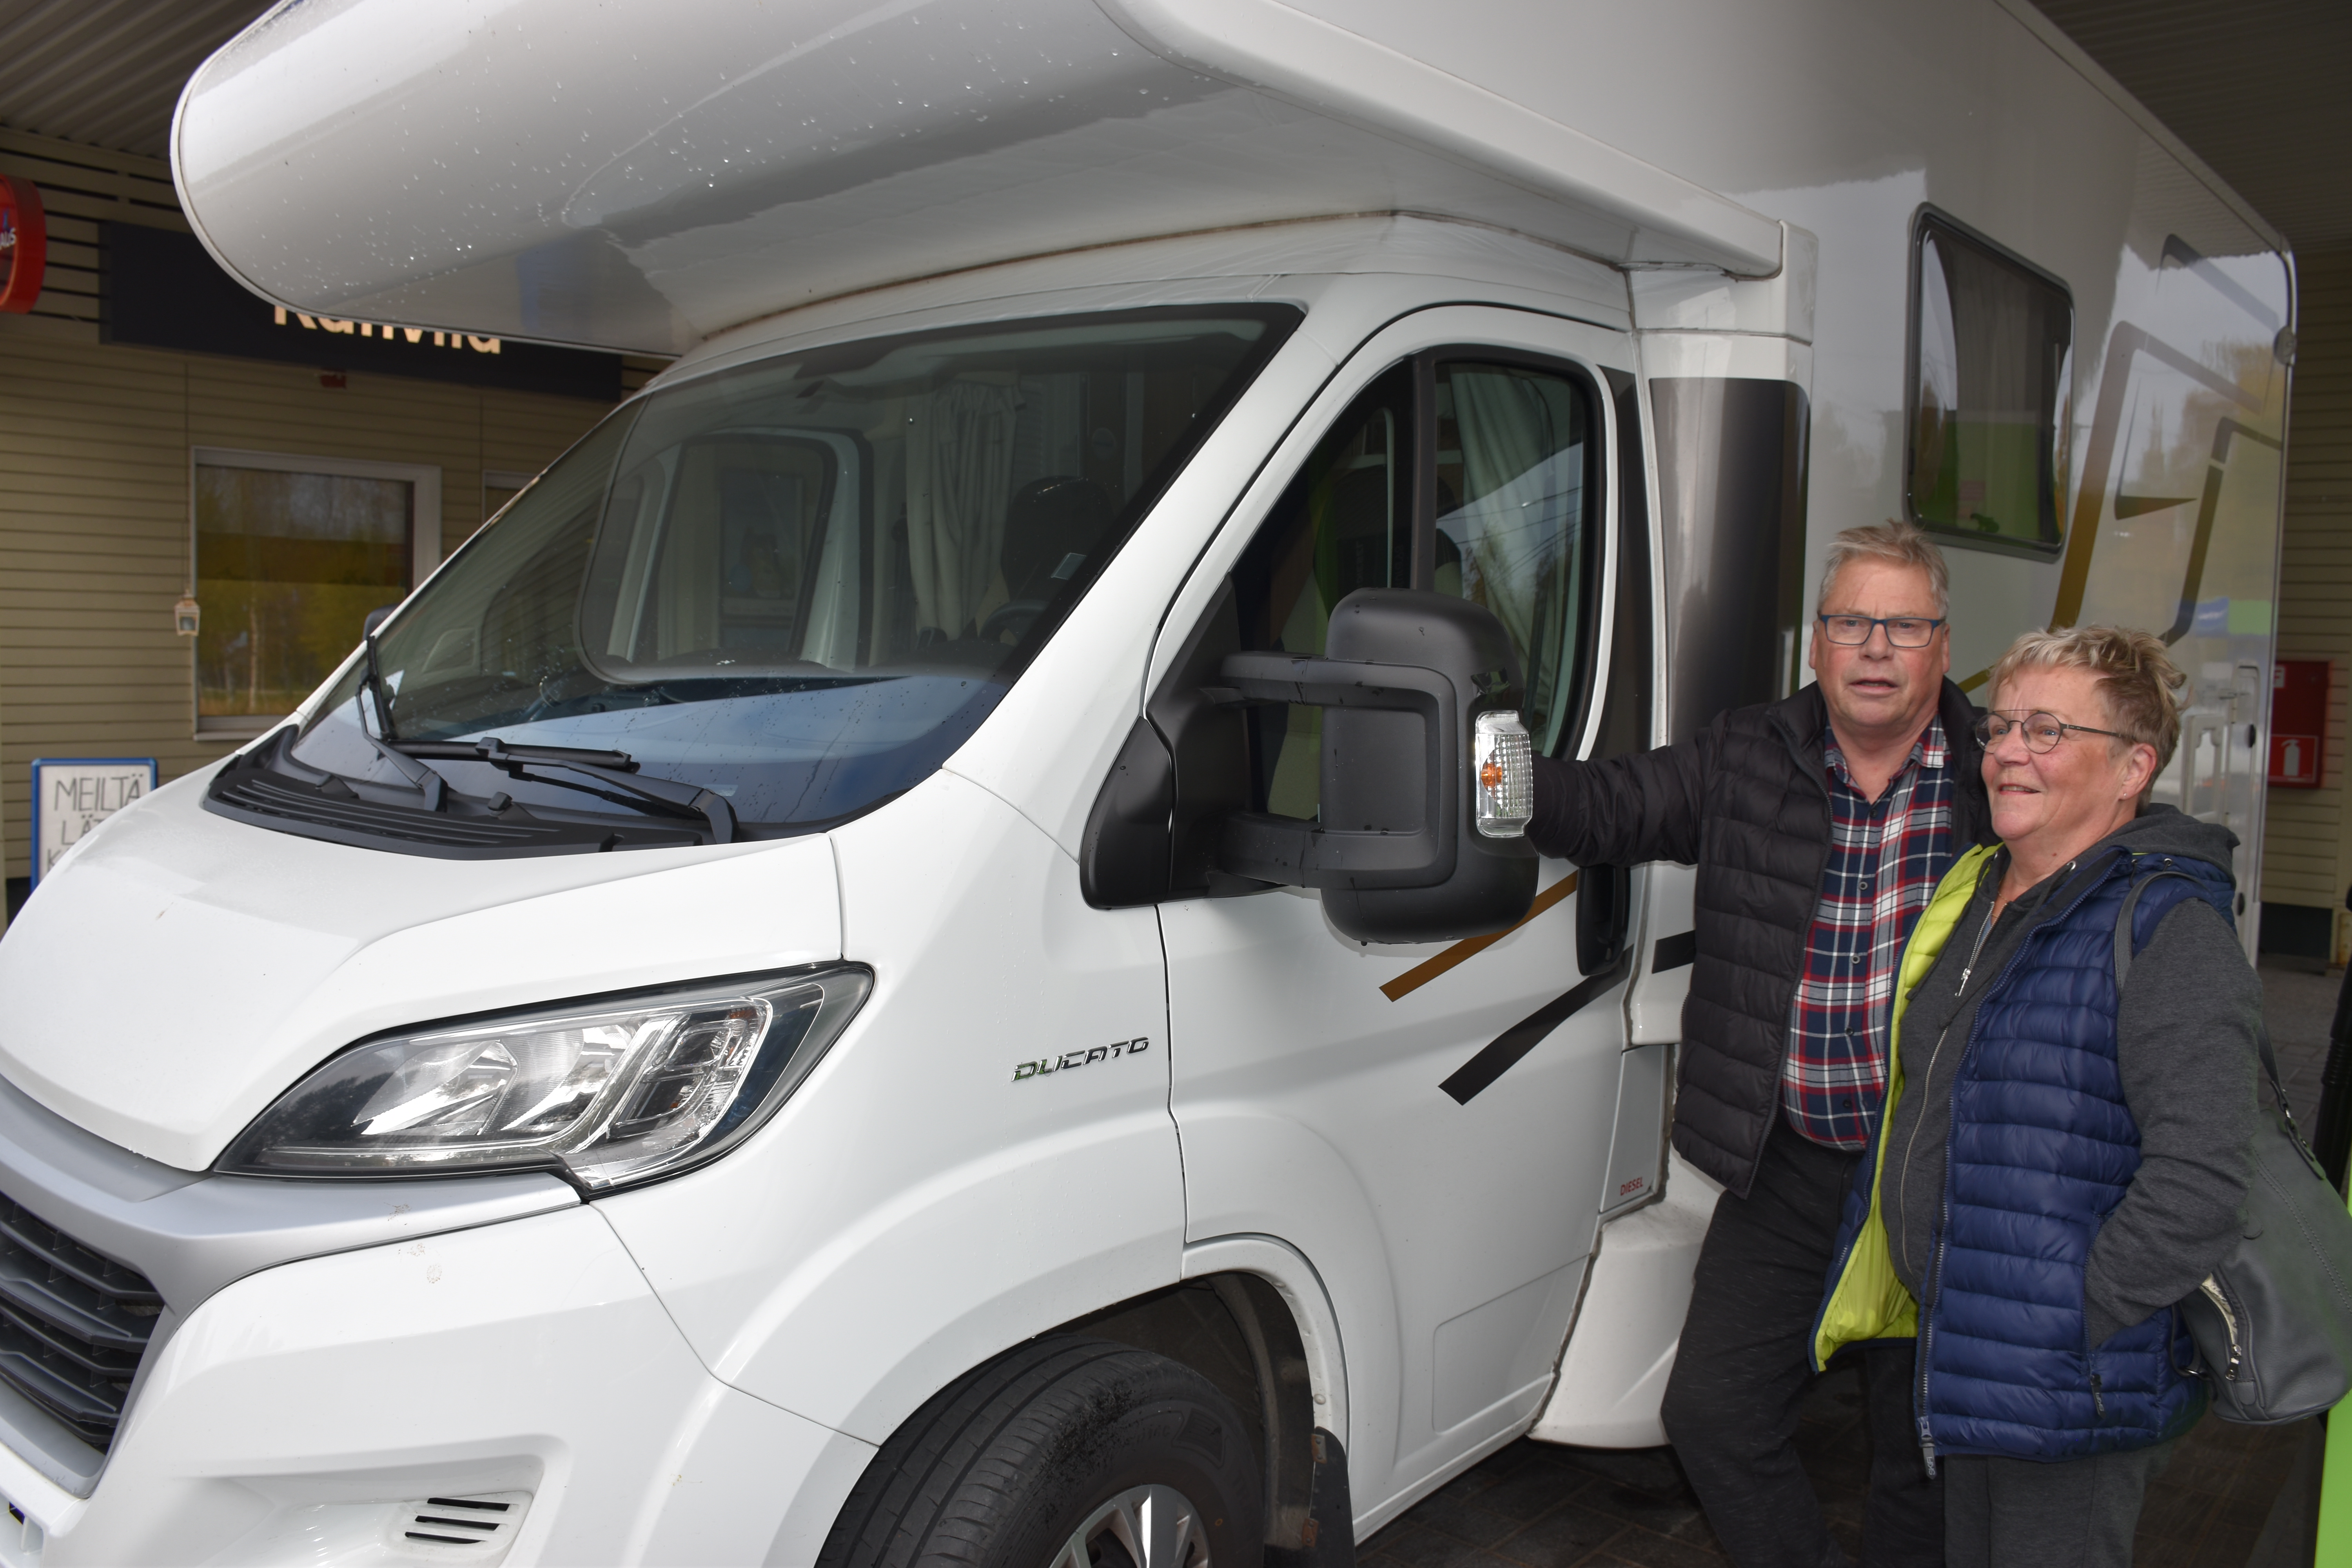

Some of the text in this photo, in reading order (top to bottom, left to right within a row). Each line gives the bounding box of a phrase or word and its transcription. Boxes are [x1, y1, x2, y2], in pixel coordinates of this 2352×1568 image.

[54, 773, 143, 811] MEILTÄ
[1011, 1036, 1149, 1082] DUCATO
[1620, 1176, 1643, 1196] DIESEL
